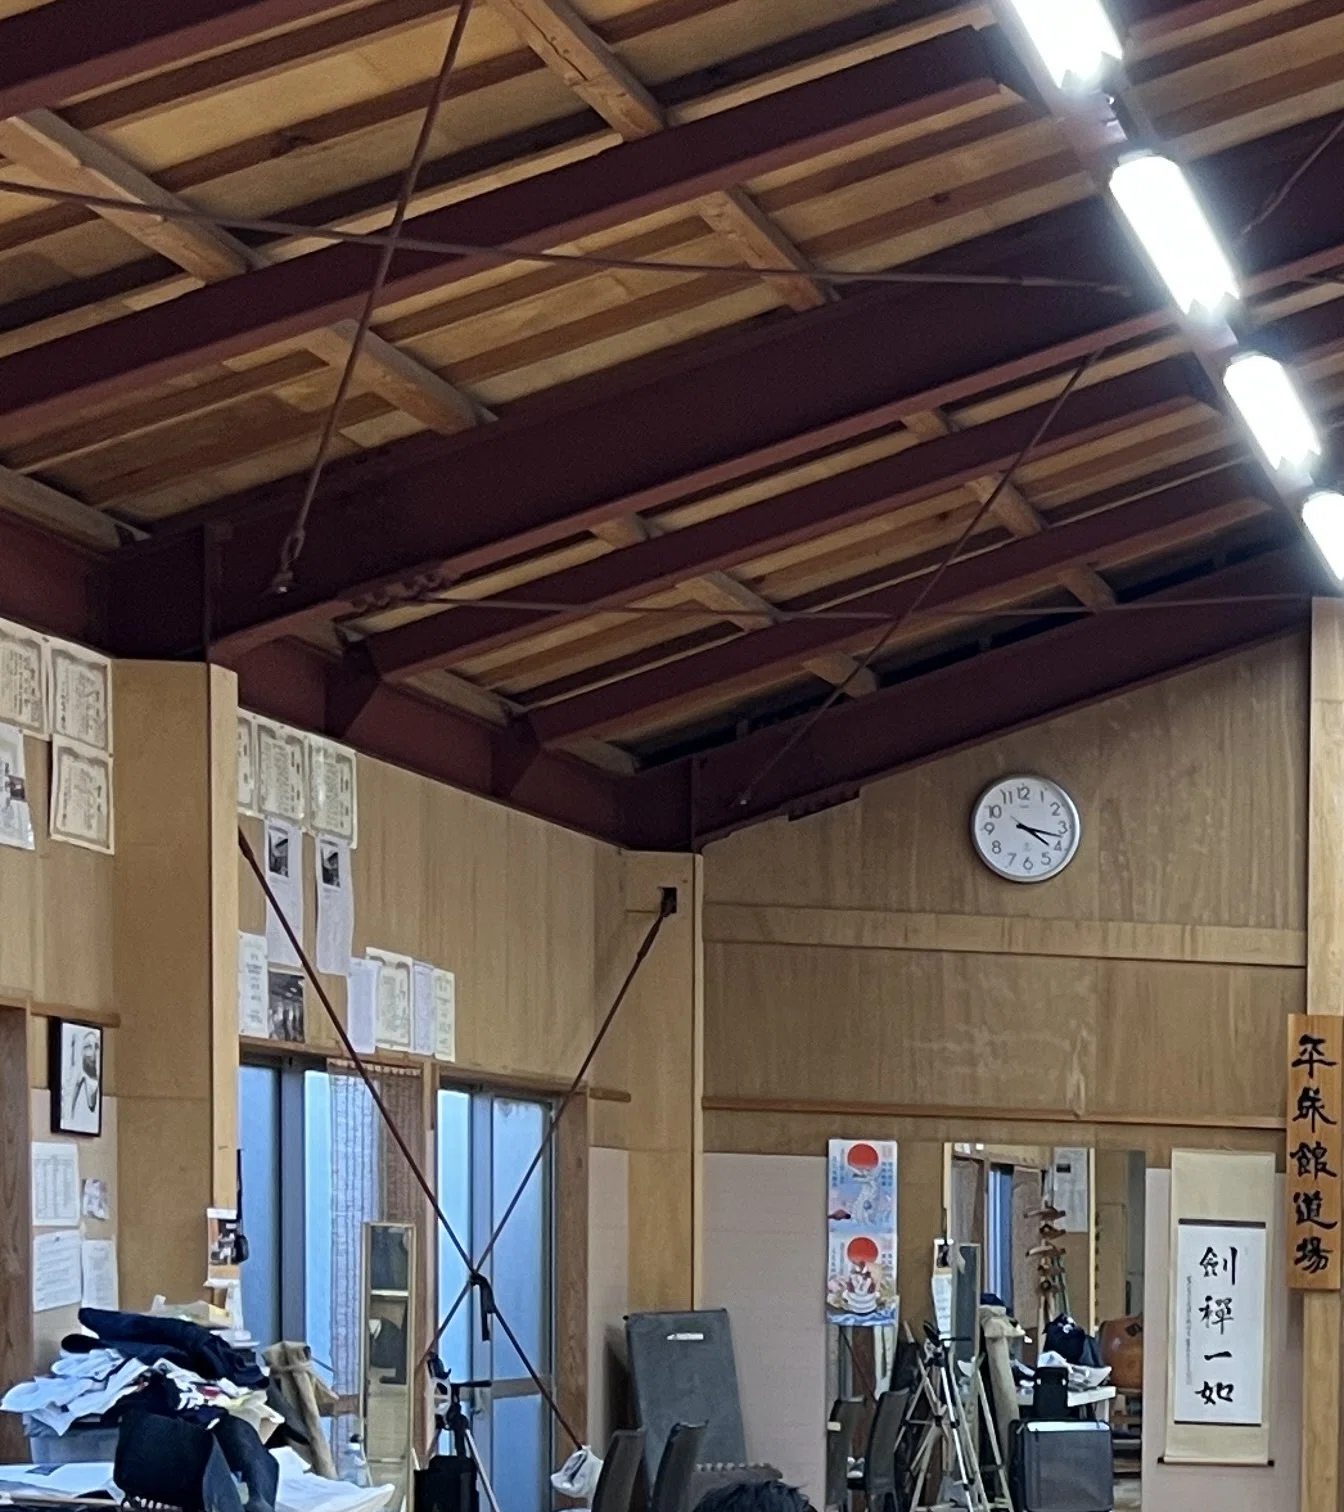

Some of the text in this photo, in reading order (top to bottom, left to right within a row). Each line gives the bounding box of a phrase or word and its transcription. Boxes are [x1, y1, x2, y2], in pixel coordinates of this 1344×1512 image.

[1000, 789, 1013, 804] 11
[1017, 785, 1030, 800] 12
[988, 805, 1002, 819] 10
[1050, 802, 1061, 816] 2
[984, 822, 995, 835] 9
[1058, 821, 1068, 835] 3
[992, 840, 1001, 854] 8
[1054, 840, 1062, 851] 4
[1007, 853, 1017, 866] 7
[1023, 857, 1033, 870] 6
[1041, 852, 1051, 865] 5
